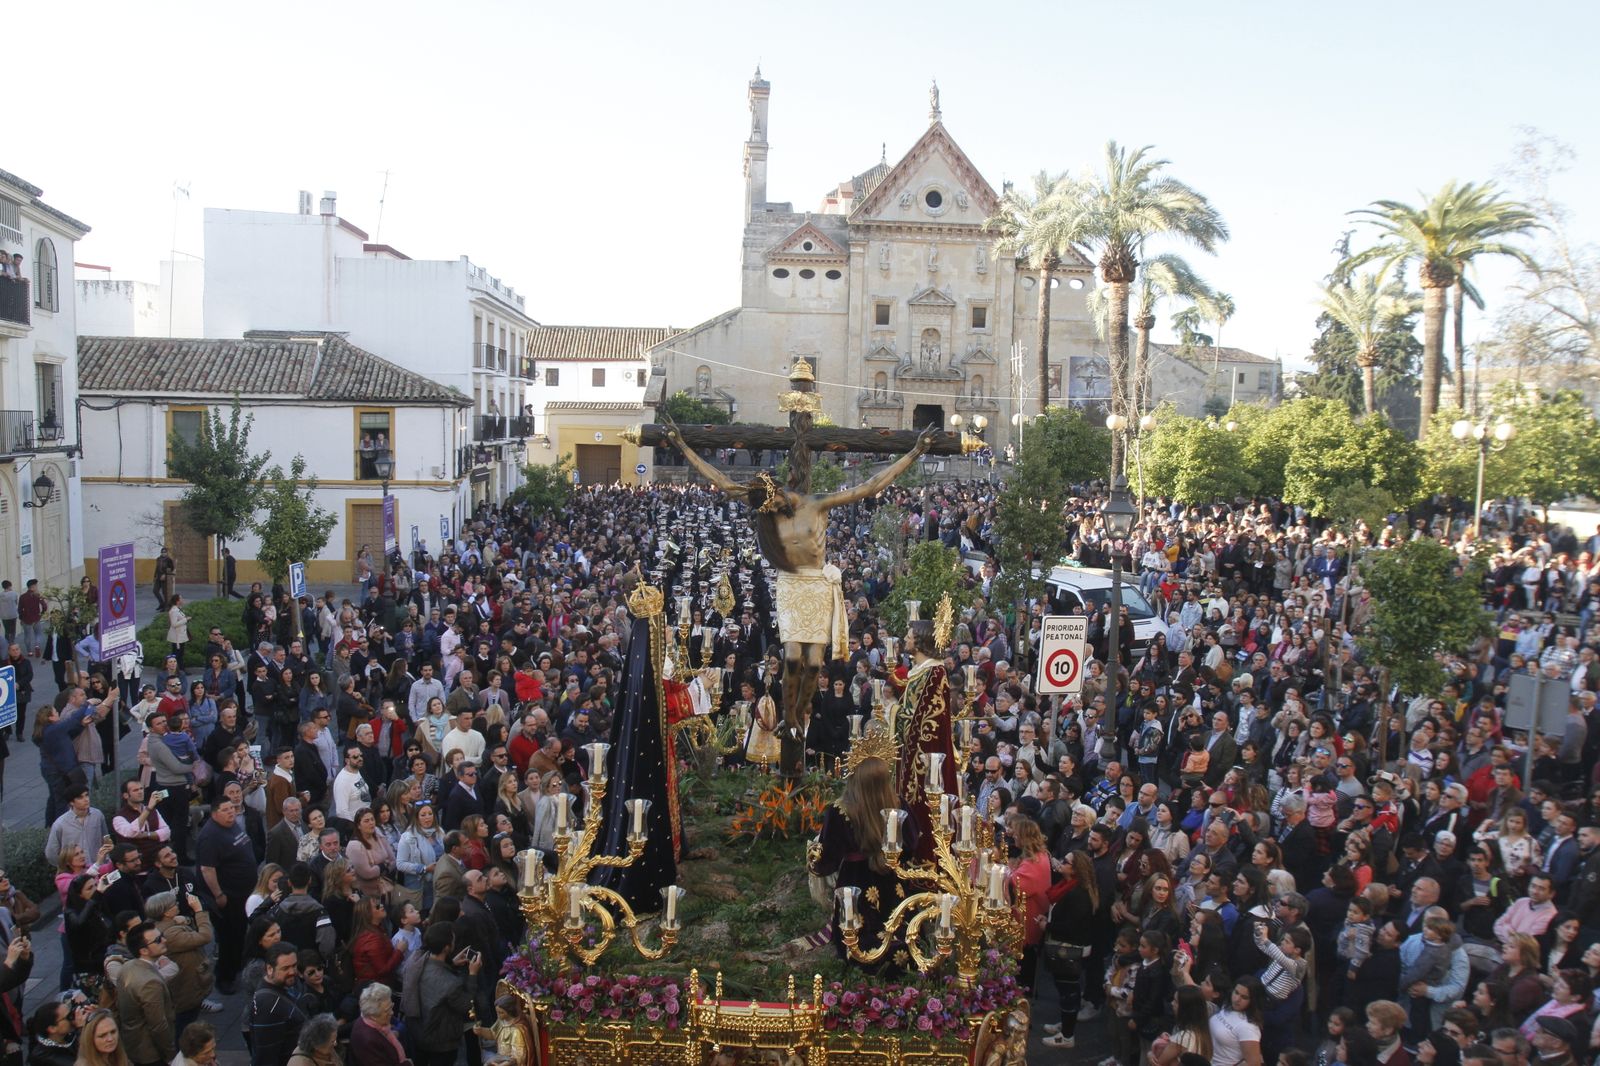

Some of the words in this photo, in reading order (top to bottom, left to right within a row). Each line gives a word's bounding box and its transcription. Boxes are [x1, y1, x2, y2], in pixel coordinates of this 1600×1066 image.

[294, 567, 302, 594] P
[1046, 624, 1084, 632] PRIORIDAD
[1045, 633, 1083, 641] PEATONAL
[1054, 661, 1070, 675] 10
